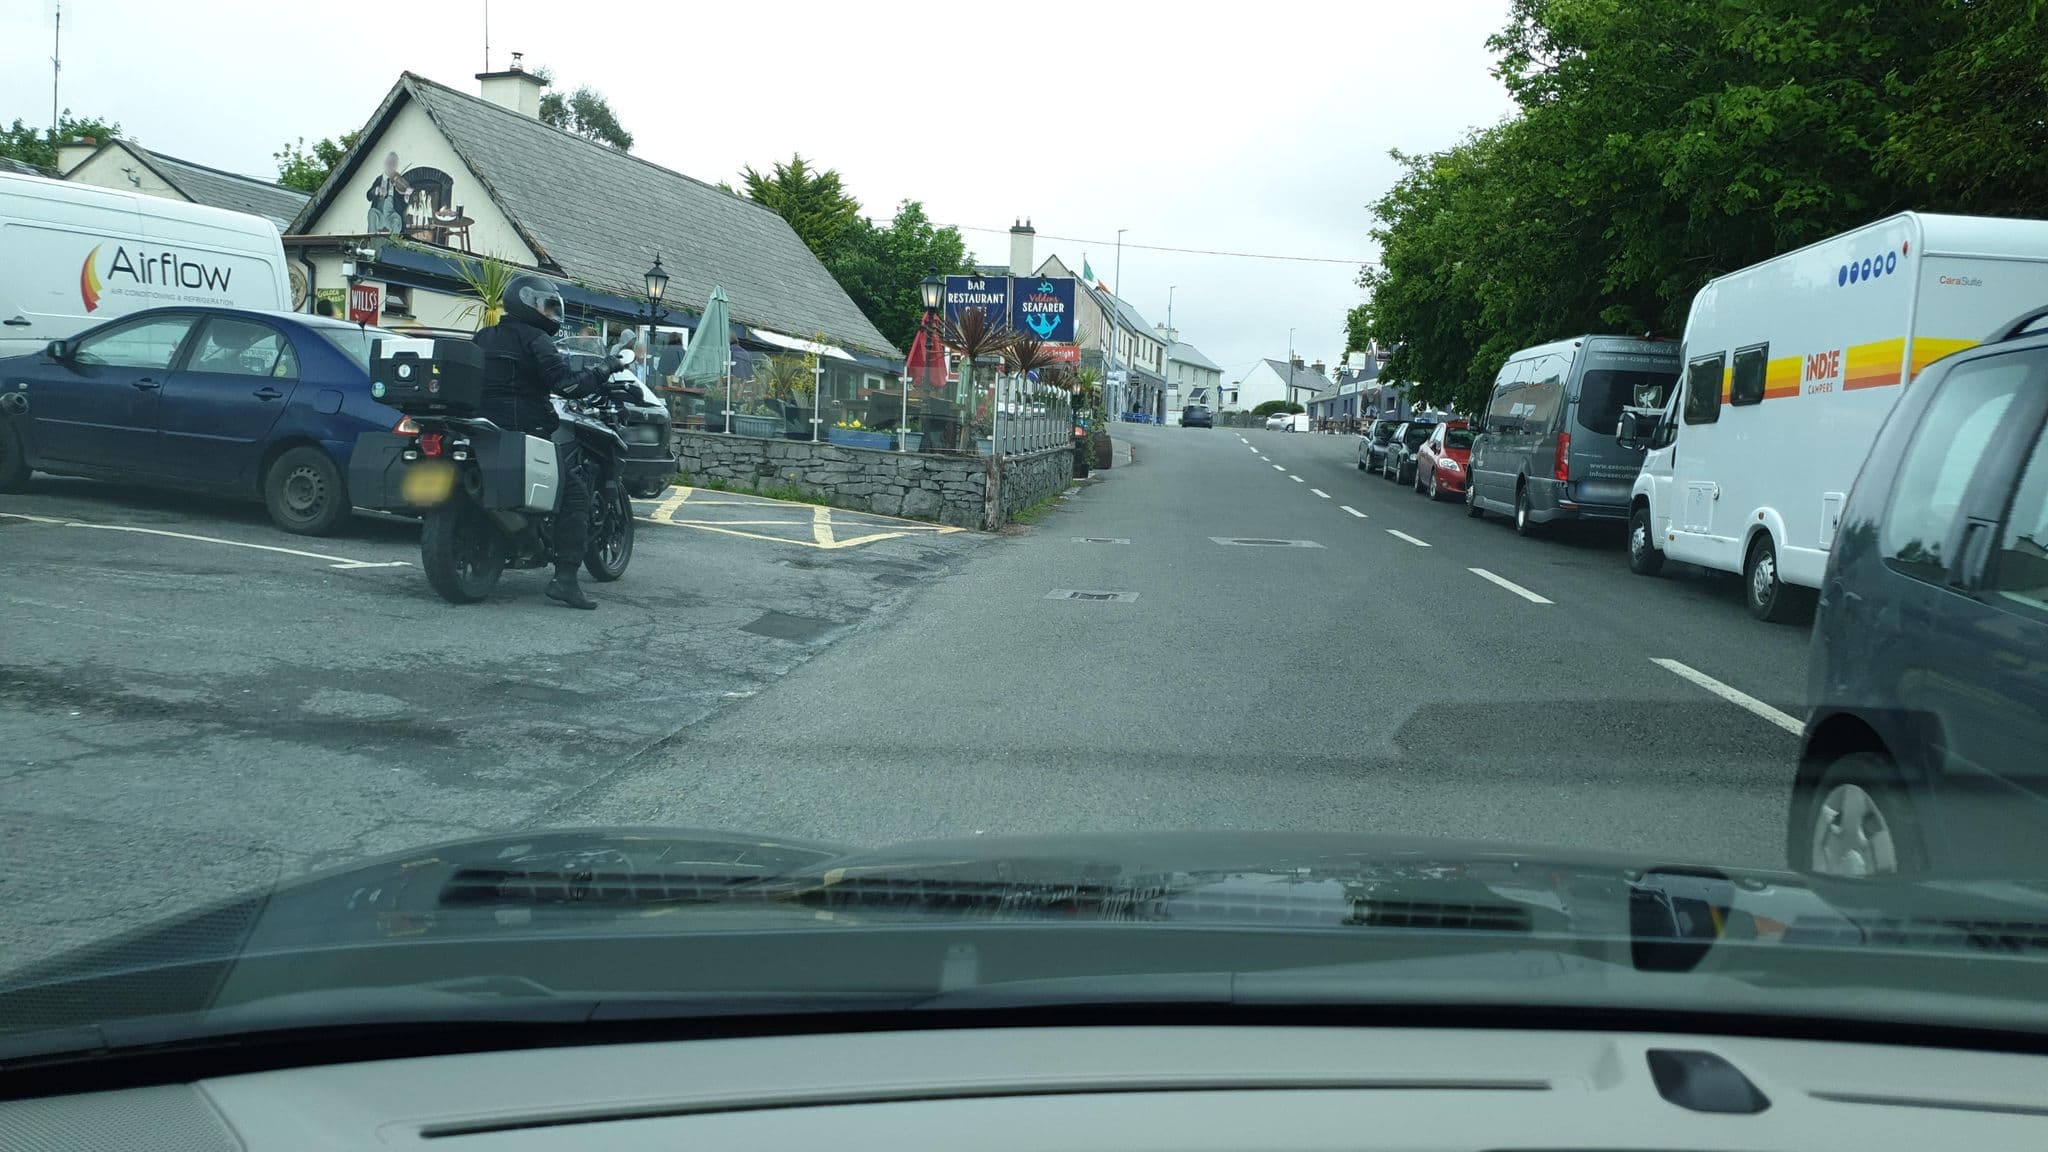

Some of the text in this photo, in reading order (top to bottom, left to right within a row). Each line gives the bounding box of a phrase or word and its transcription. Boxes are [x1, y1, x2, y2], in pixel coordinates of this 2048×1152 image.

[108, 246, 231, 292] Airflow
[967, 280, 985, 290] BAR
[948, 293, 1004, 304] RESTAURANT
[1022, 302, 1064, 313] SEAFARER
[1808, 382, 1833, 395] CAMPERS
